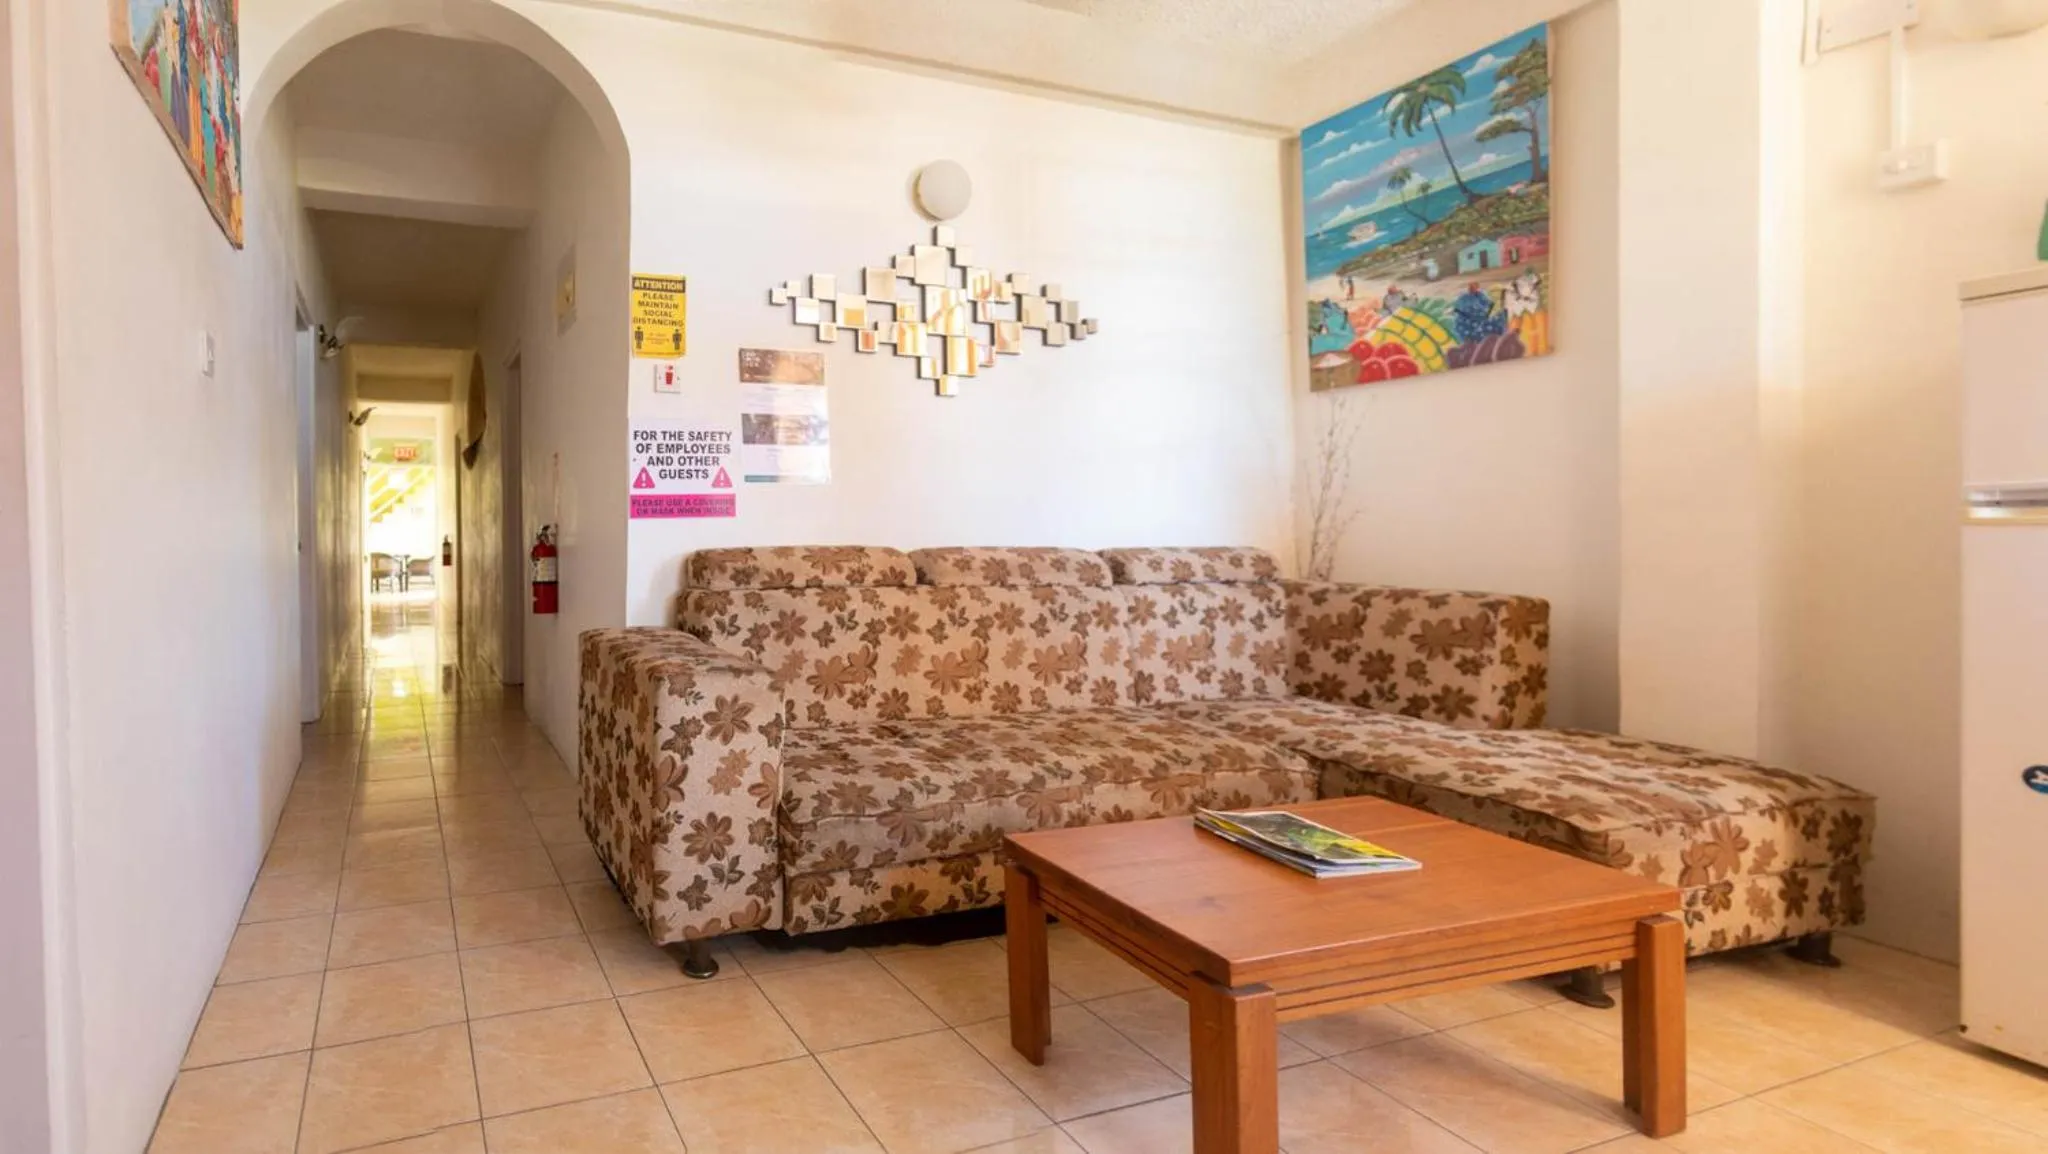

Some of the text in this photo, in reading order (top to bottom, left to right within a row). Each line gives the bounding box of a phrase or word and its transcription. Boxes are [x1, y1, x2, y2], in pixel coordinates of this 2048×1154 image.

[634, 279, 684, 291] ATTENTION
[642, 292, 674, 300] PLEASE
[638, 300, 679, 309] MAINTAIN
[644, 309, 673, 317] SOCIAL
[633, 317, 684, 327] DISTANCING
[633, 430, 732, 442] FOR THE SAFETY
[636, 443, 731, 454] OF EMPLOYEES
[647, 456, 720, 467] AND OTHER
[659, 469, 709, 480] GUESTS
[632, 498, 663, 506] PLEASE
[677, 507, 701, 515] WHEN
